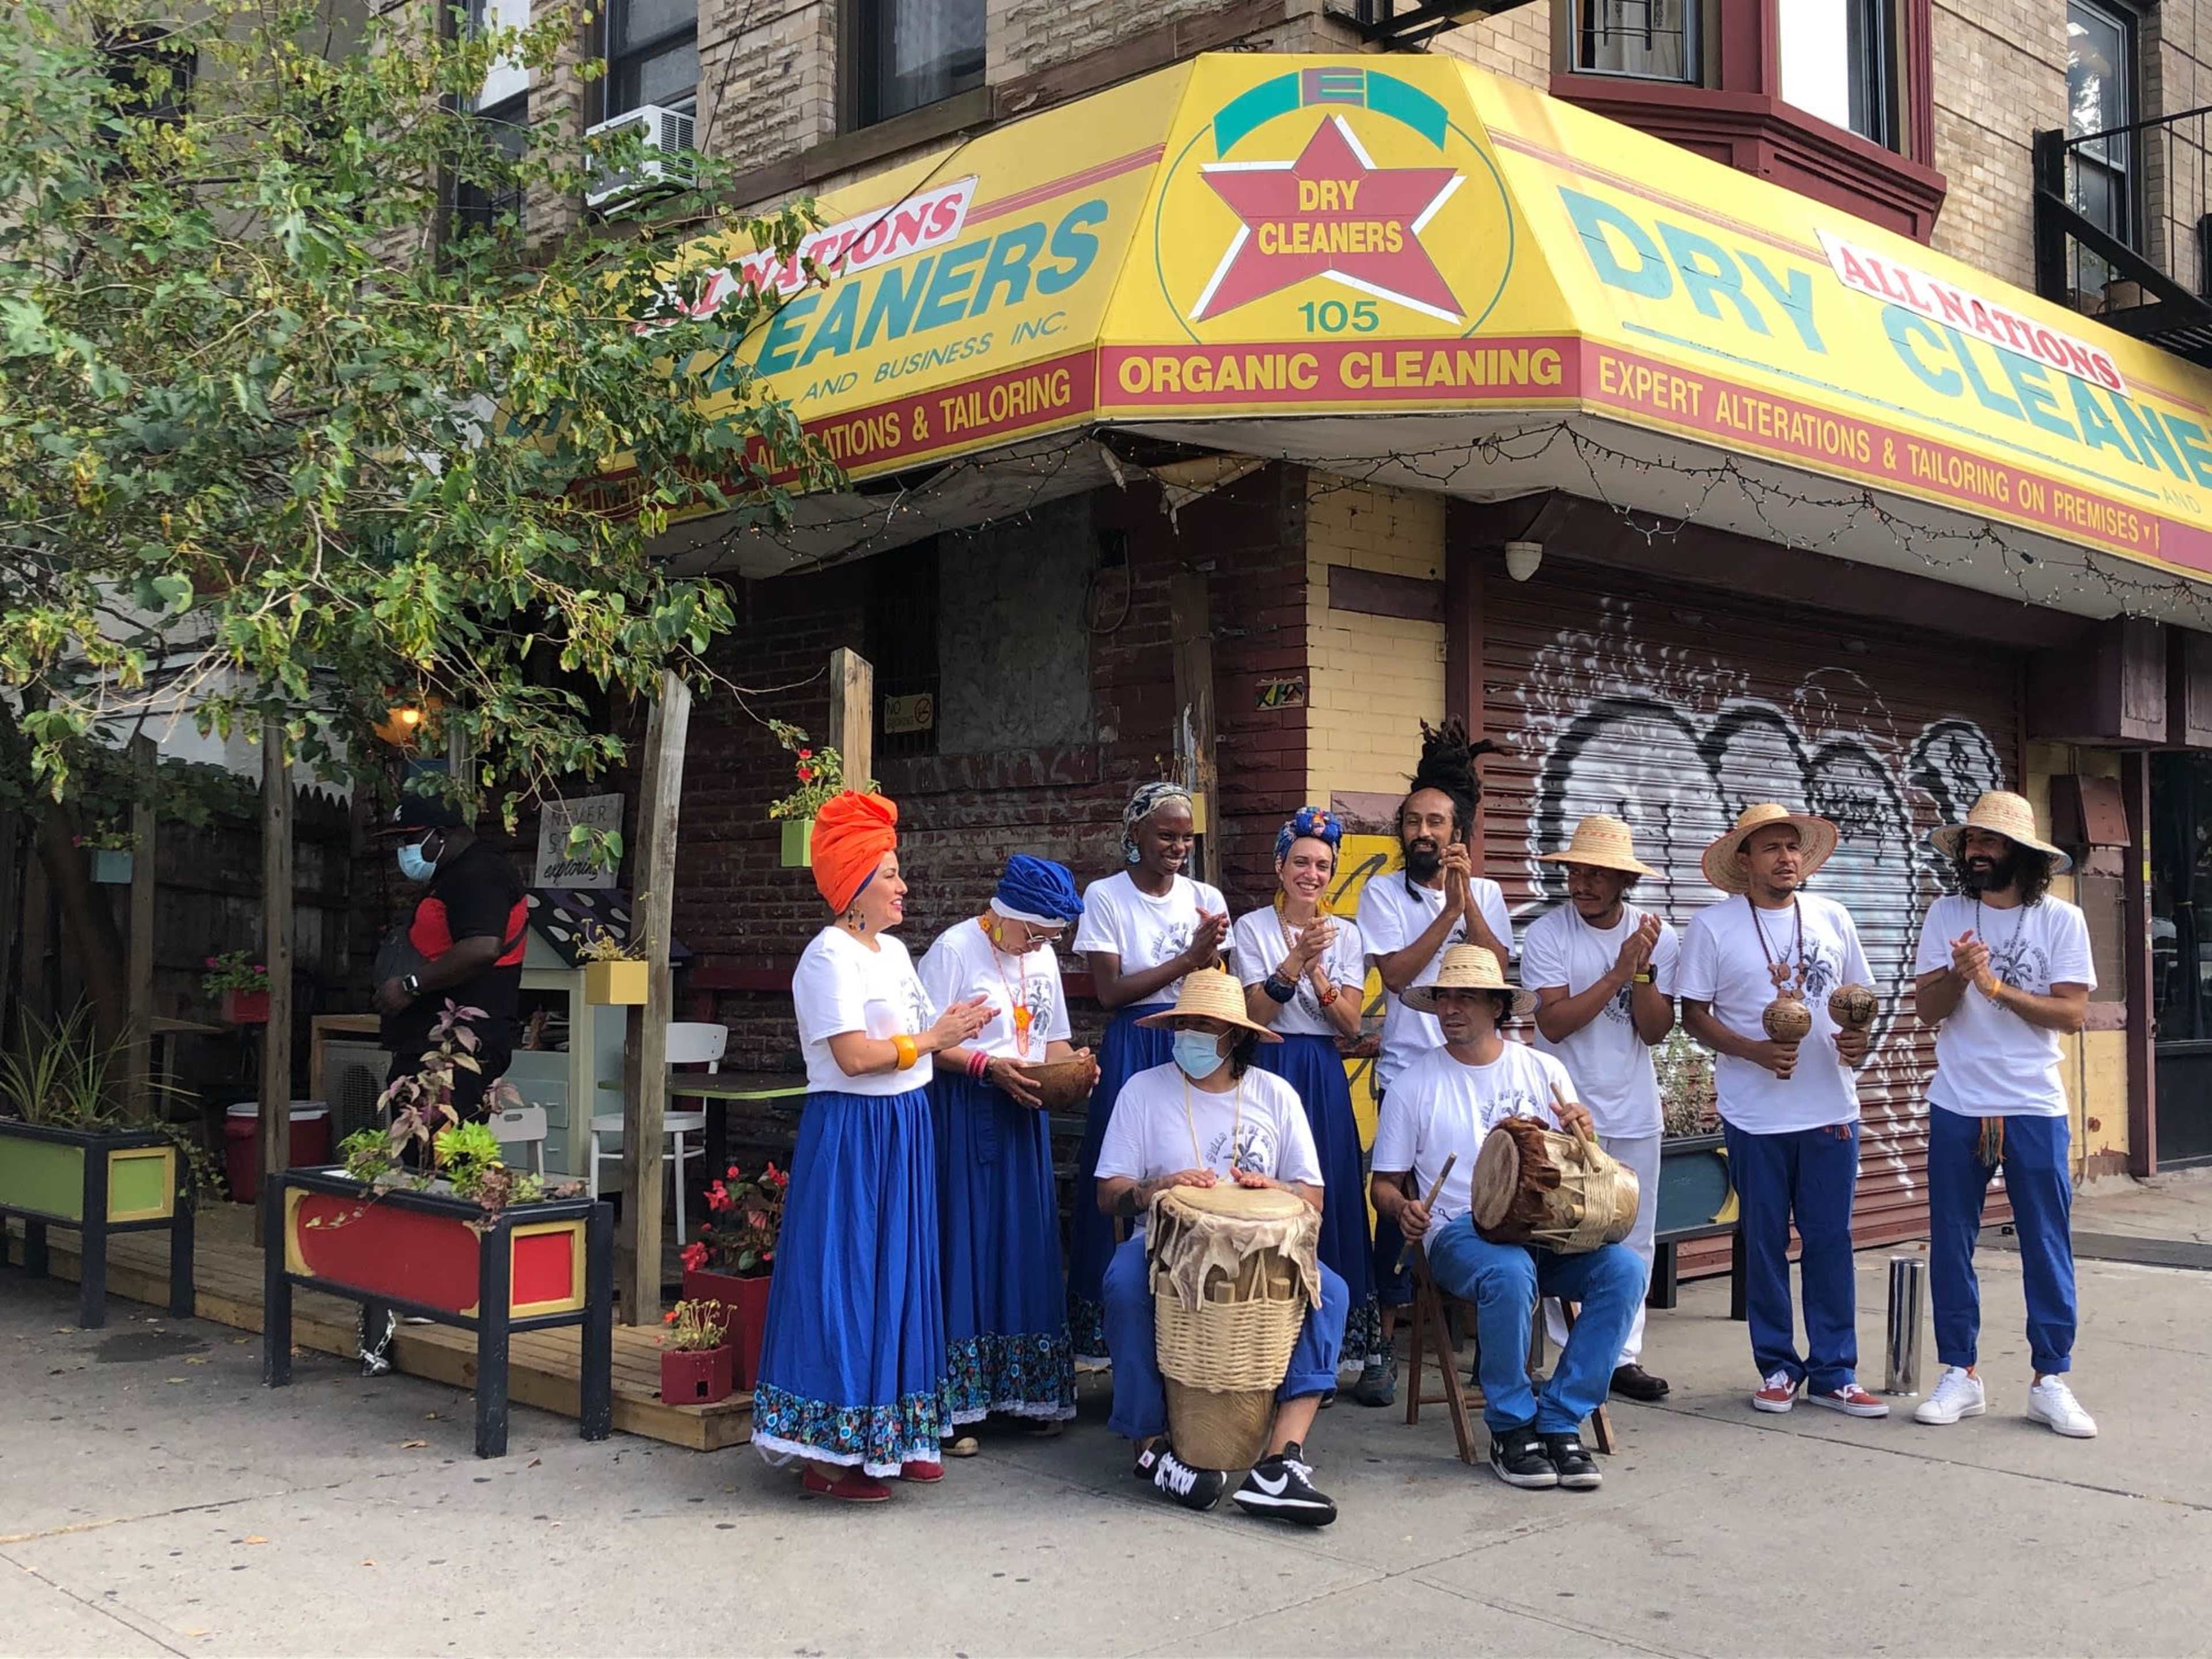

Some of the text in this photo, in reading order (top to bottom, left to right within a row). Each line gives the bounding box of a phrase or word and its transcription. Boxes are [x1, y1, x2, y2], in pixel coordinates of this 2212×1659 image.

[1299, 180, 1360, 211] DRY
[1257, 221, 1404, 255] CLEANERS
[1297, 300, 1380, 333] 105
[1556, 184, 2212, 490] DRY CLEANE
[1840, 245, 2122, 391] ALL NATIONS
[799, 311, 1069, 404] AND BUSINESS INC.
[1118, 347, 1563, 394] ORGANIC CLEANING
[912, 407, 929, 441] &
[938, 368, 1071, 433] TAILORING
[1599, 355, 1703, 417] EXPERT
[1715, 391, 1872, 464] ALTERATIONS
[1882, 437, 1897, 471] &
[1907, 444, 2010, 504] TAILORING
[2018, 478, 2045, 514] ON
[2053, 488, 2140, 543] PREMISES
[2162, 486, 2202, 514] AND
